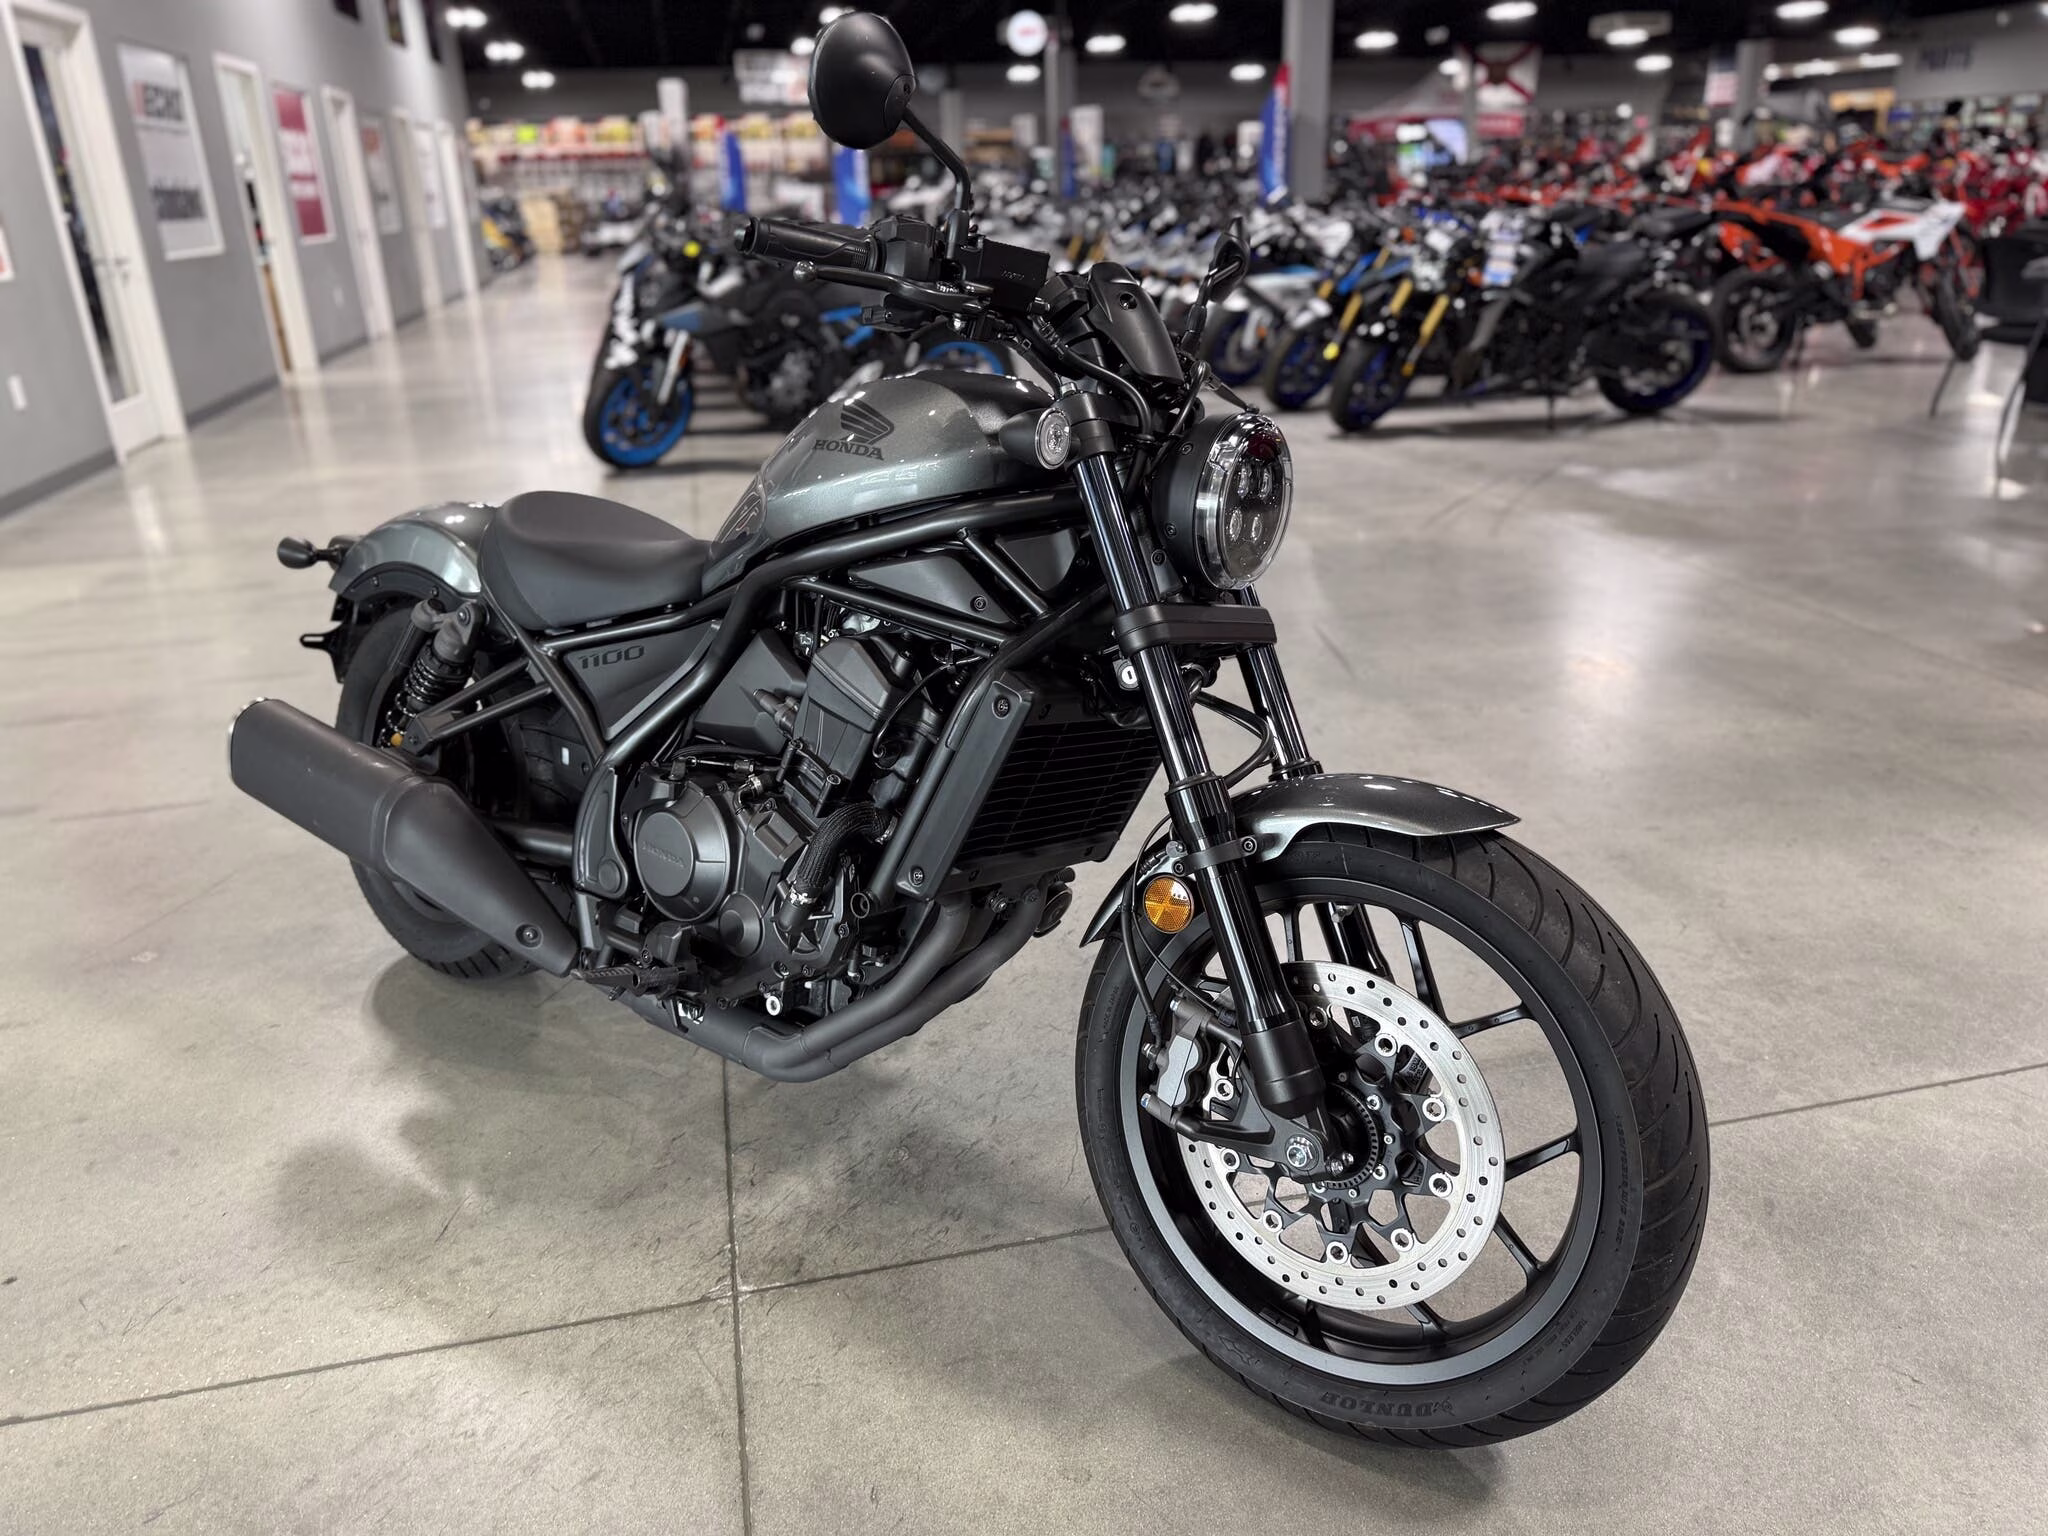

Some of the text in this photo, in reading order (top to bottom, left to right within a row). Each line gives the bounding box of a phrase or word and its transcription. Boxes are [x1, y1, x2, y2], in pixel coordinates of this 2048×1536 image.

[812, 439, 884, 460] HONDA
[578, 645, 644, 669] 1100
[1319, 1391, 1433, 1417] DUNLOP
